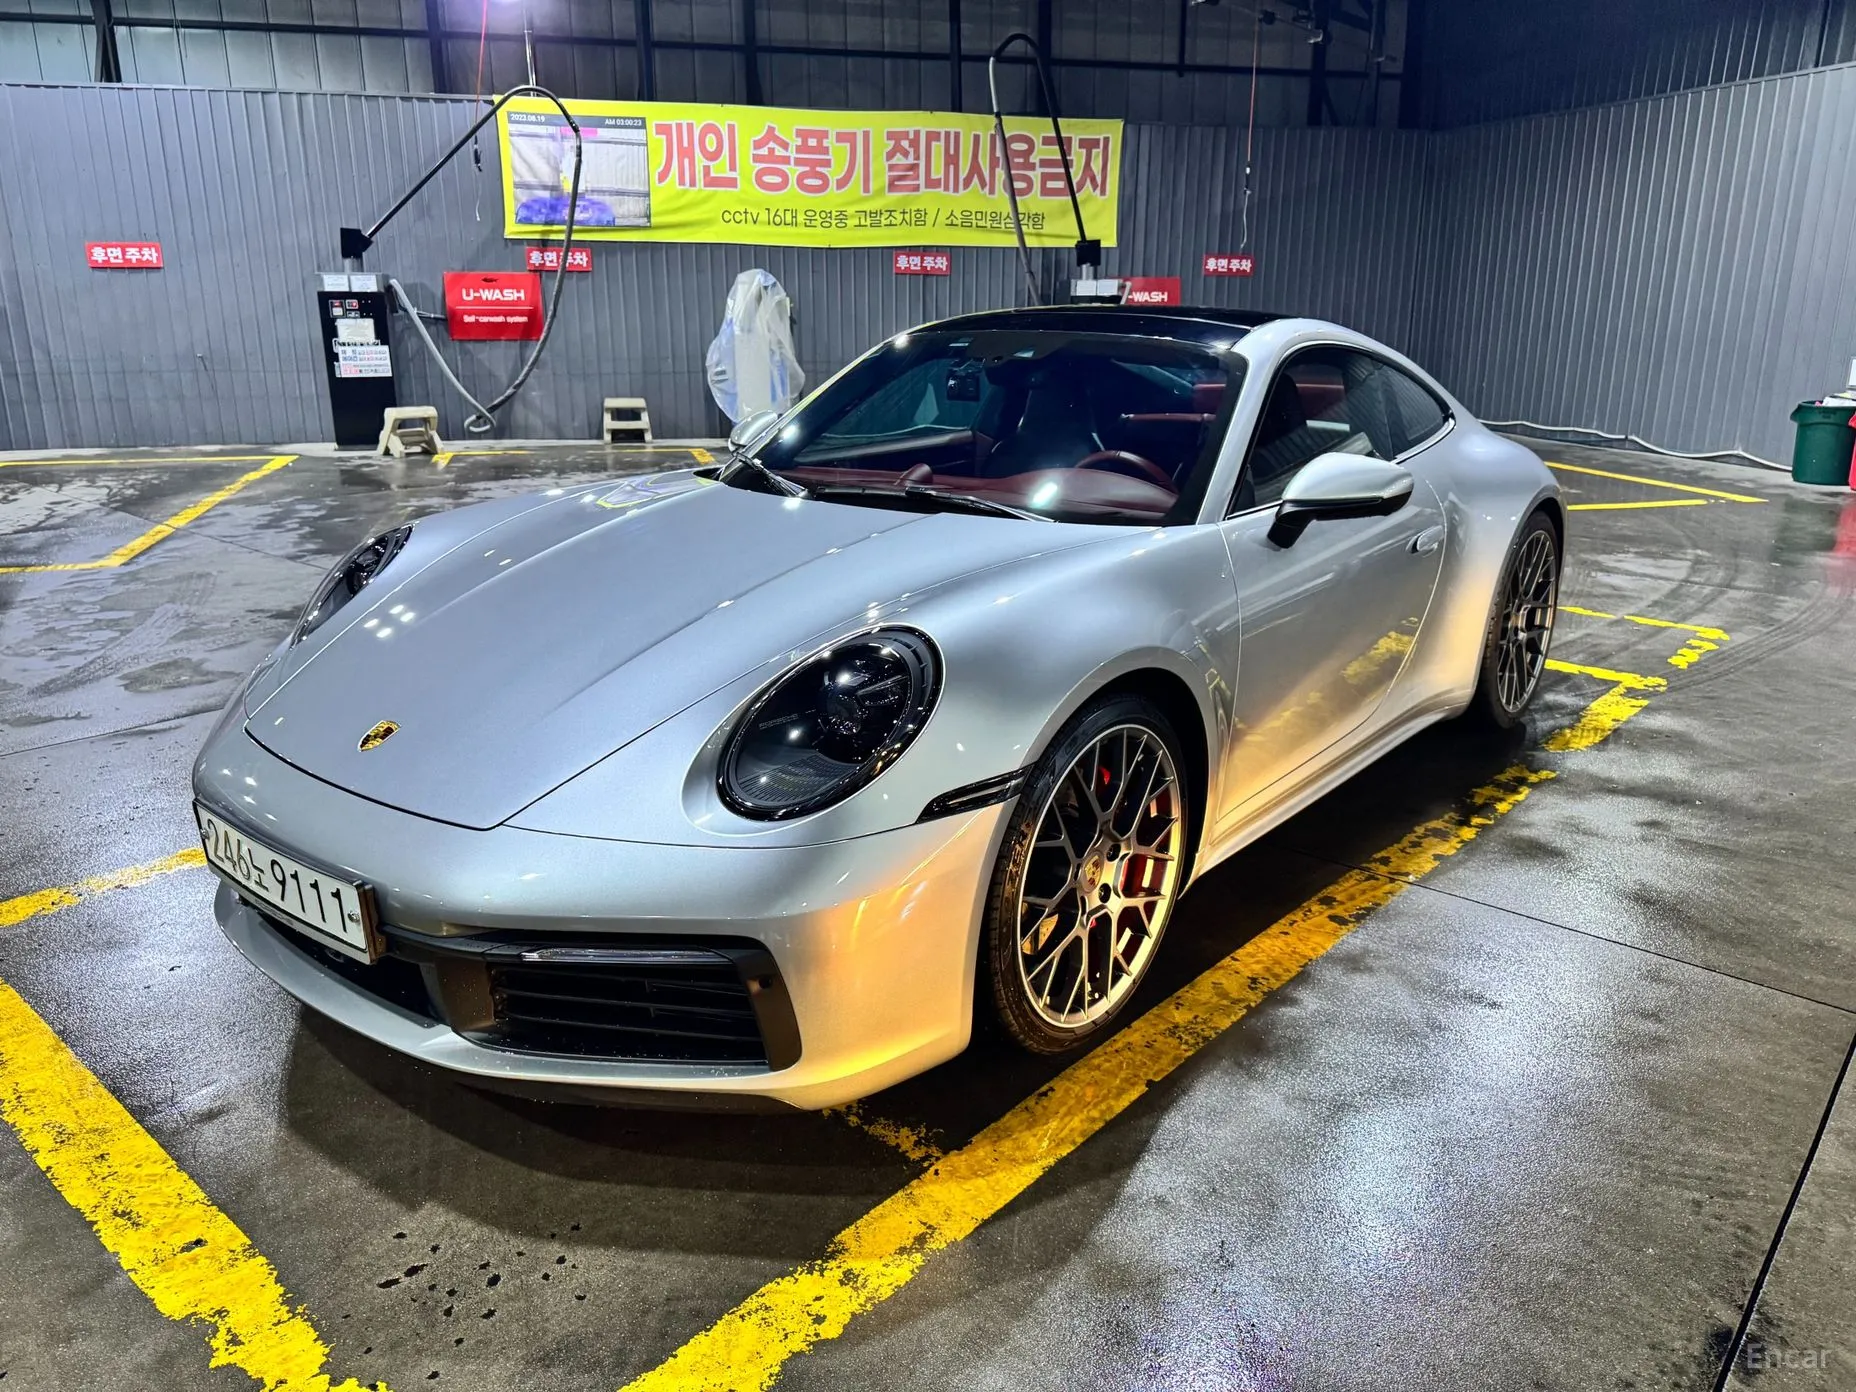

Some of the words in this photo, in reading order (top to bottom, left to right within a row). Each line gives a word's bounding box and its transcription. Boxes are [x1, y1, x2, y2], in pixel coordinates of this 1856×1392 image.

[654, 122, 740, 190] 개인
[751, 124, 872, 195] 송풍기
[885, 128, 1111, 198] 절대사용금지
[721, 208, 760, 225] cctv
[765, 207, 798, 227] 16대
[803, 209, 849, 229] 운영중
[854, 208, 928, 228] 고발조치함
[91, 246, 124, 264] 후면
[125, 247, 158, 264] 주차
[530, 251, 558, 267] 후면
[896, 255, 921, 270] 후면
[922, 256, 948, 271] 주차
[1205, 257, 1228, 272] 후면
[1229, 258, 1252, 273] 주차
[462, 288, 525, 301] U-WASH
[1128, 291, 1168, 302] -WASH
